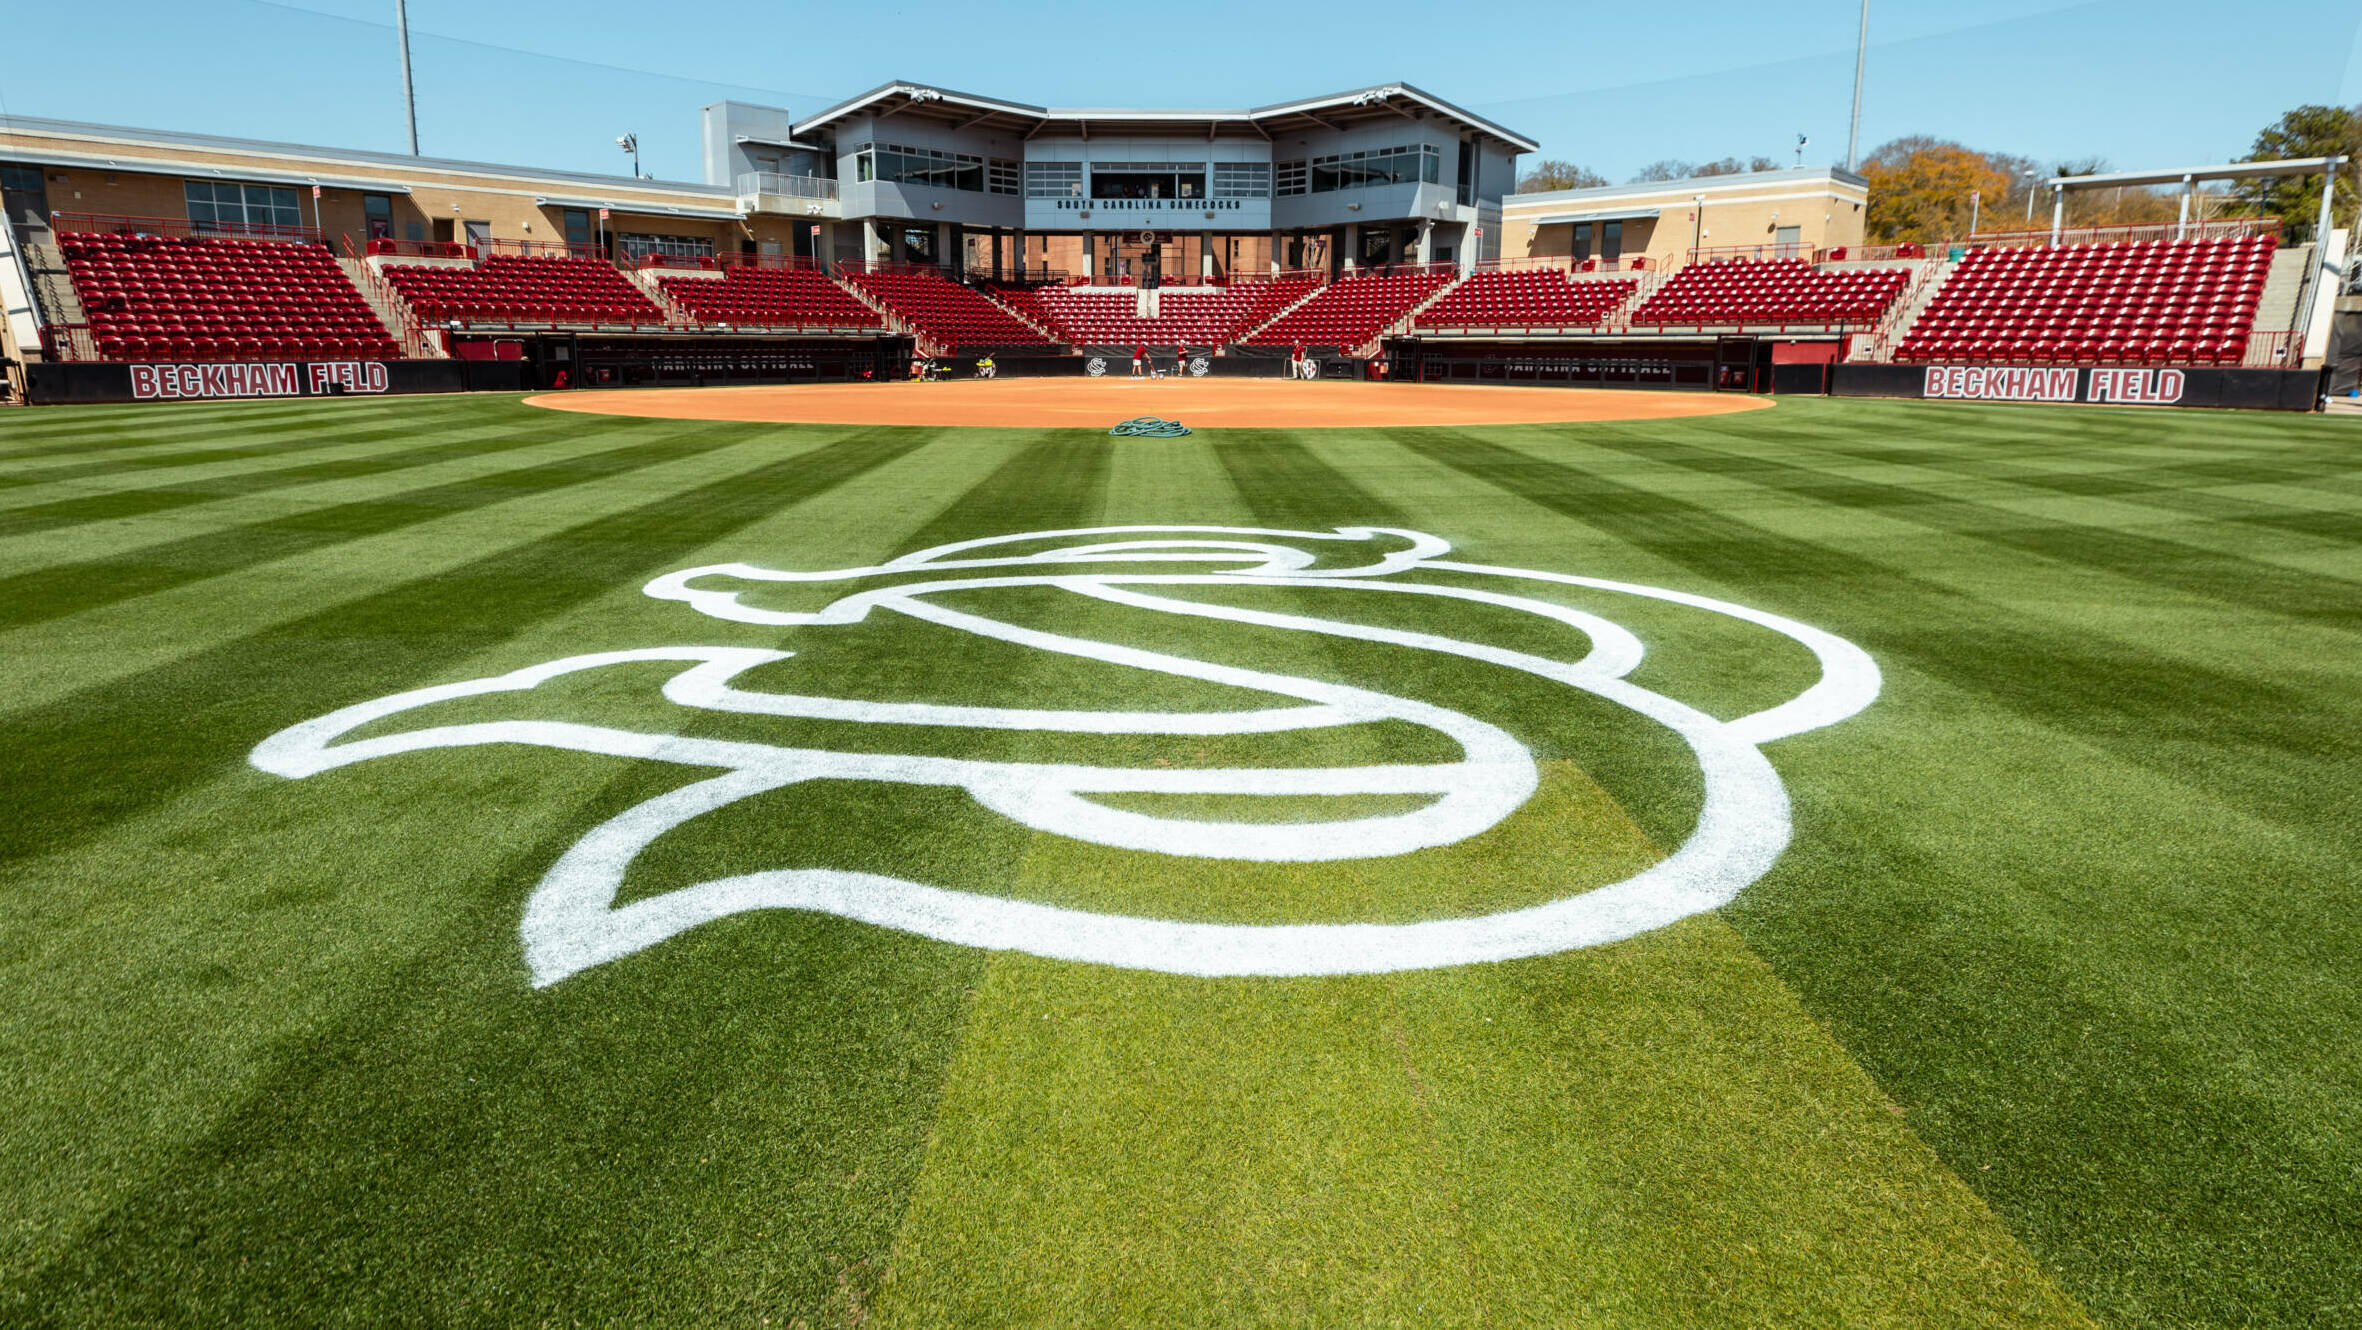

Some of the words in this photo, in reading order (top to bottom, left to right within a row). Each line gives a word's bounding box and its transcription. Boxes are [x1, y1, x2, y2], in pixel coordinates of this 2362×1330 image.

[1057, 200, 1095, 209] SOUTH
[1103, 200, 1162, 209] CAROLINA
[1170, 200, 1241, 209] GAMECOCKS
[130, 363, 300, 399] BECKHAM
[308, 362, 389, 394] FIELD
[1923, 366, 2079, 401] BECKHAM
[2087, 368, 2185, 403] FIELD
